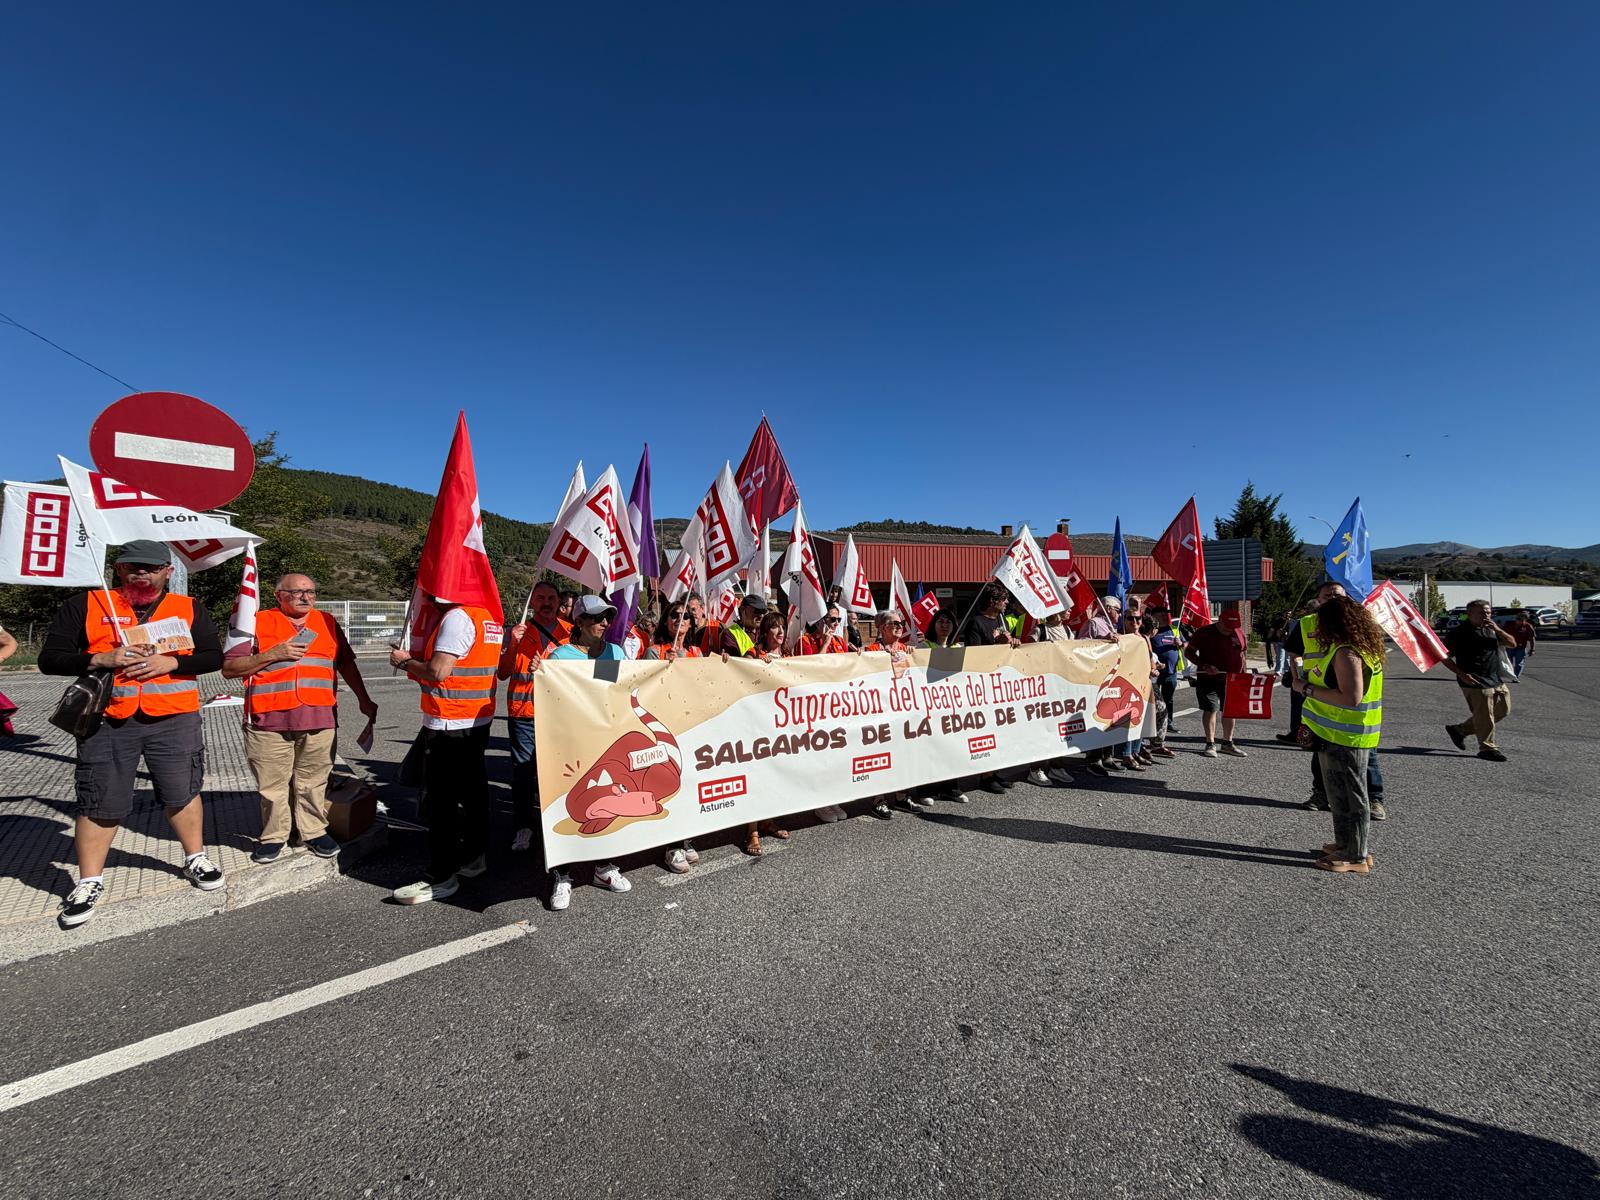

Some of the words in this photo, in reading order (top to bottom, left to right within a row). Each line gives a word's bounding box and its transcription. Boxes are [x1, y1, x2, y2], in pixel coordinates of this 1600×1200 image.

[151, 512, 199, 524] León
[28, 497, 62, 572] CCOO
[774, 680, 884, 733] Supresión
[889, 676, 919, 712] del
[921, 678, 963, 719] peaje
[965, 674, 989, 707] del
[989, 672, 1047, 704] Huerna
[1059, 721, 1085, 736] CCOO
[694, 727, 847, 771] SALGAMOS
[861, 722, 892, 746] DE
[904, 717, 932, 740] LA
[941, 711, 986, 735] EDAD
[994, 706, 1017, 726] DE
[969, 737, 995, 752] CCOO
[636, 749, 664, 765] EXTINTO
[854, 754, 890, 772] CCOO
[970, 751, 991, 761] Asturies
[852, 773, 870, 783] León
[700, 778, 745, 800] CCOO
[699, 799, 736, 814] Asturies
